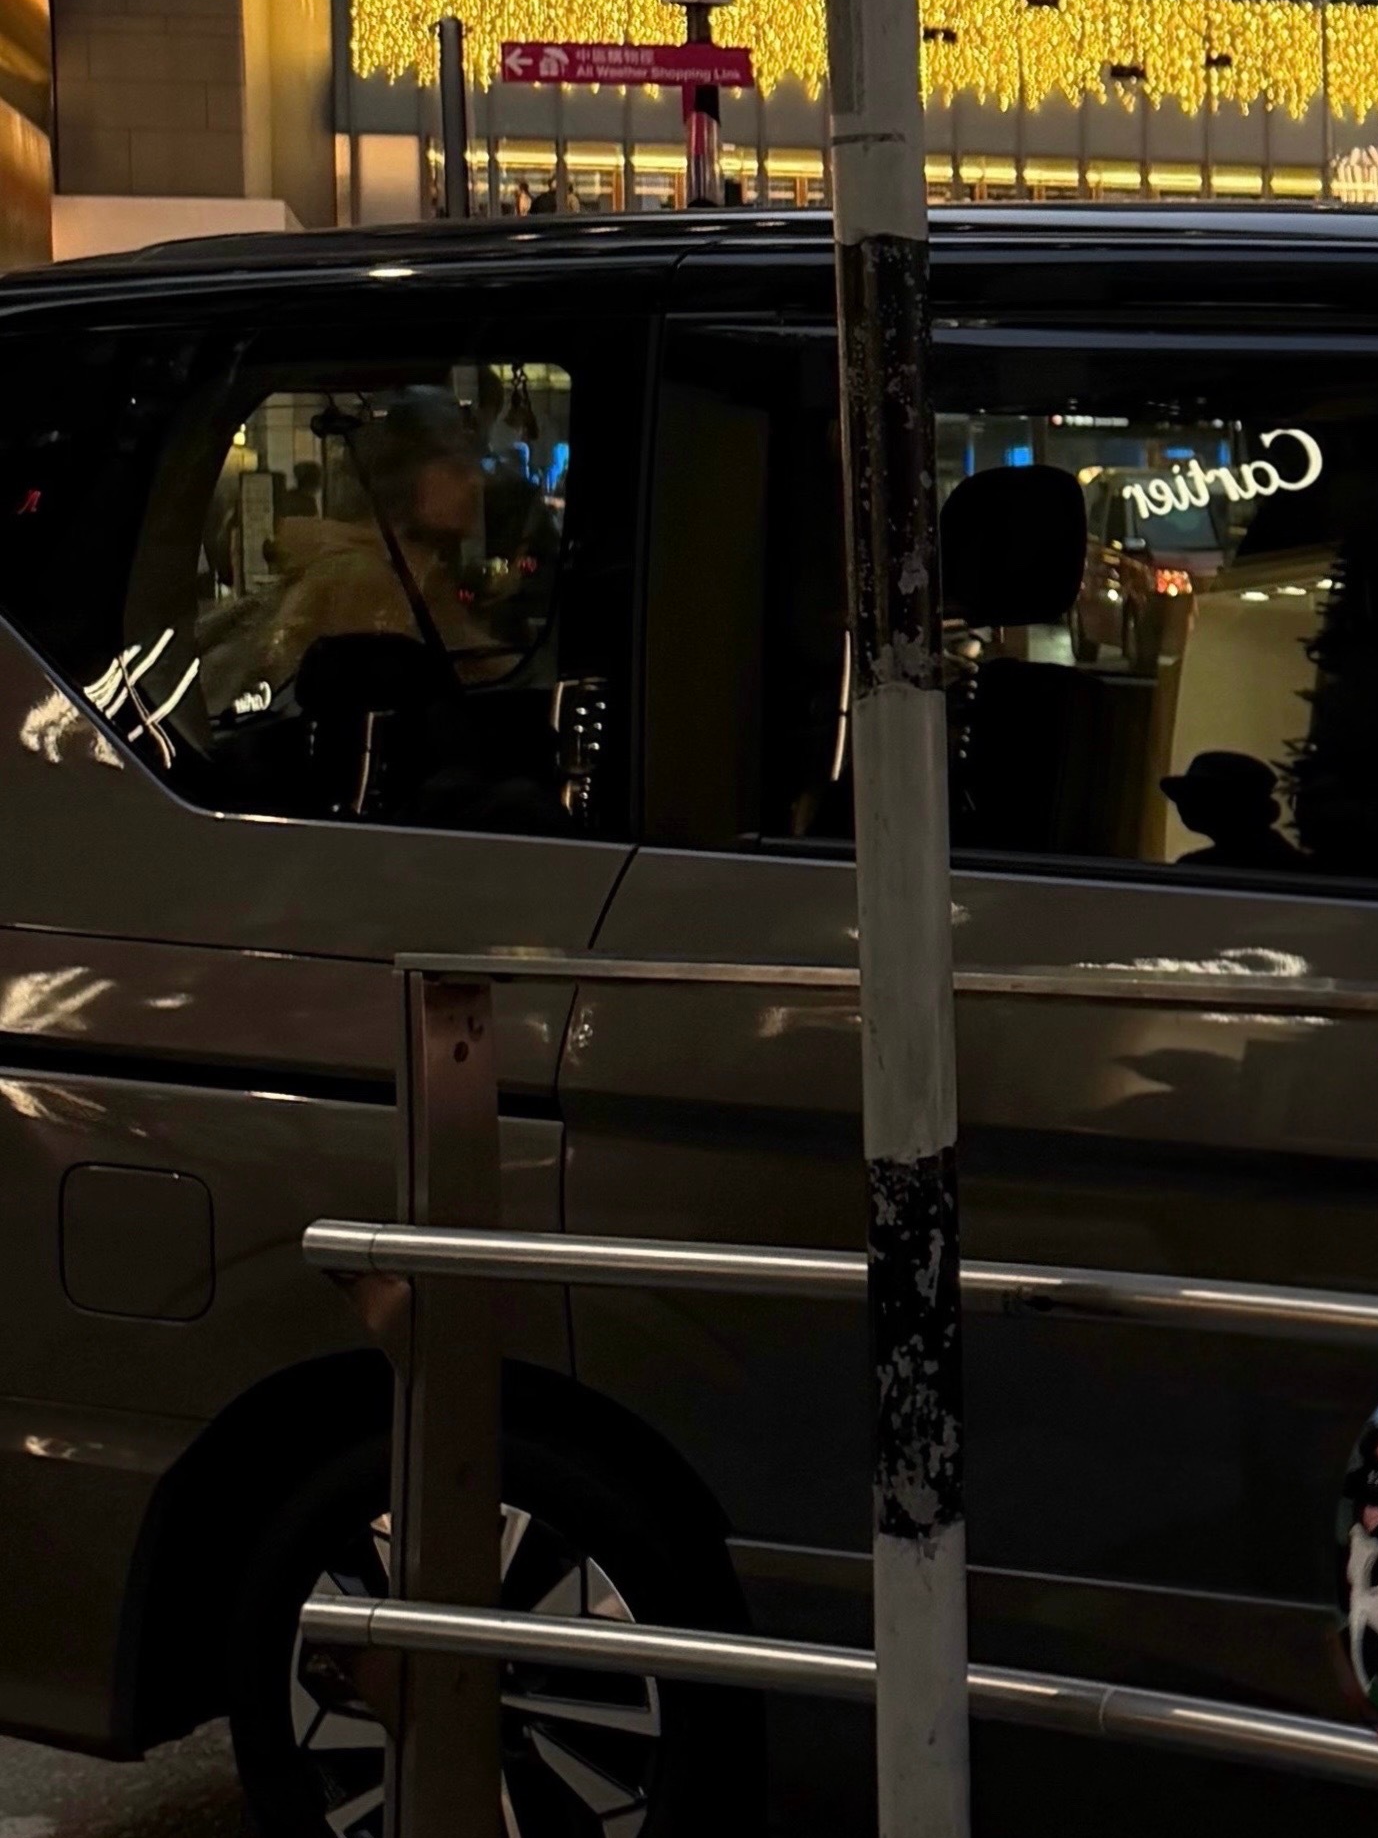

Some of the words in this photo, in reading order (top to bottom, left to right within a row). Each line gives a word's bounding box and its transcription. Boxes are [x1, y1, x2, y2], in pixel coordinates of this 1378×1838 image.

[576, 66, 593, 78] All
[597, 66, 648, 79] Weather
[651, 67, 711, 83] Shopping
[715, 69, 740, 81] Link
